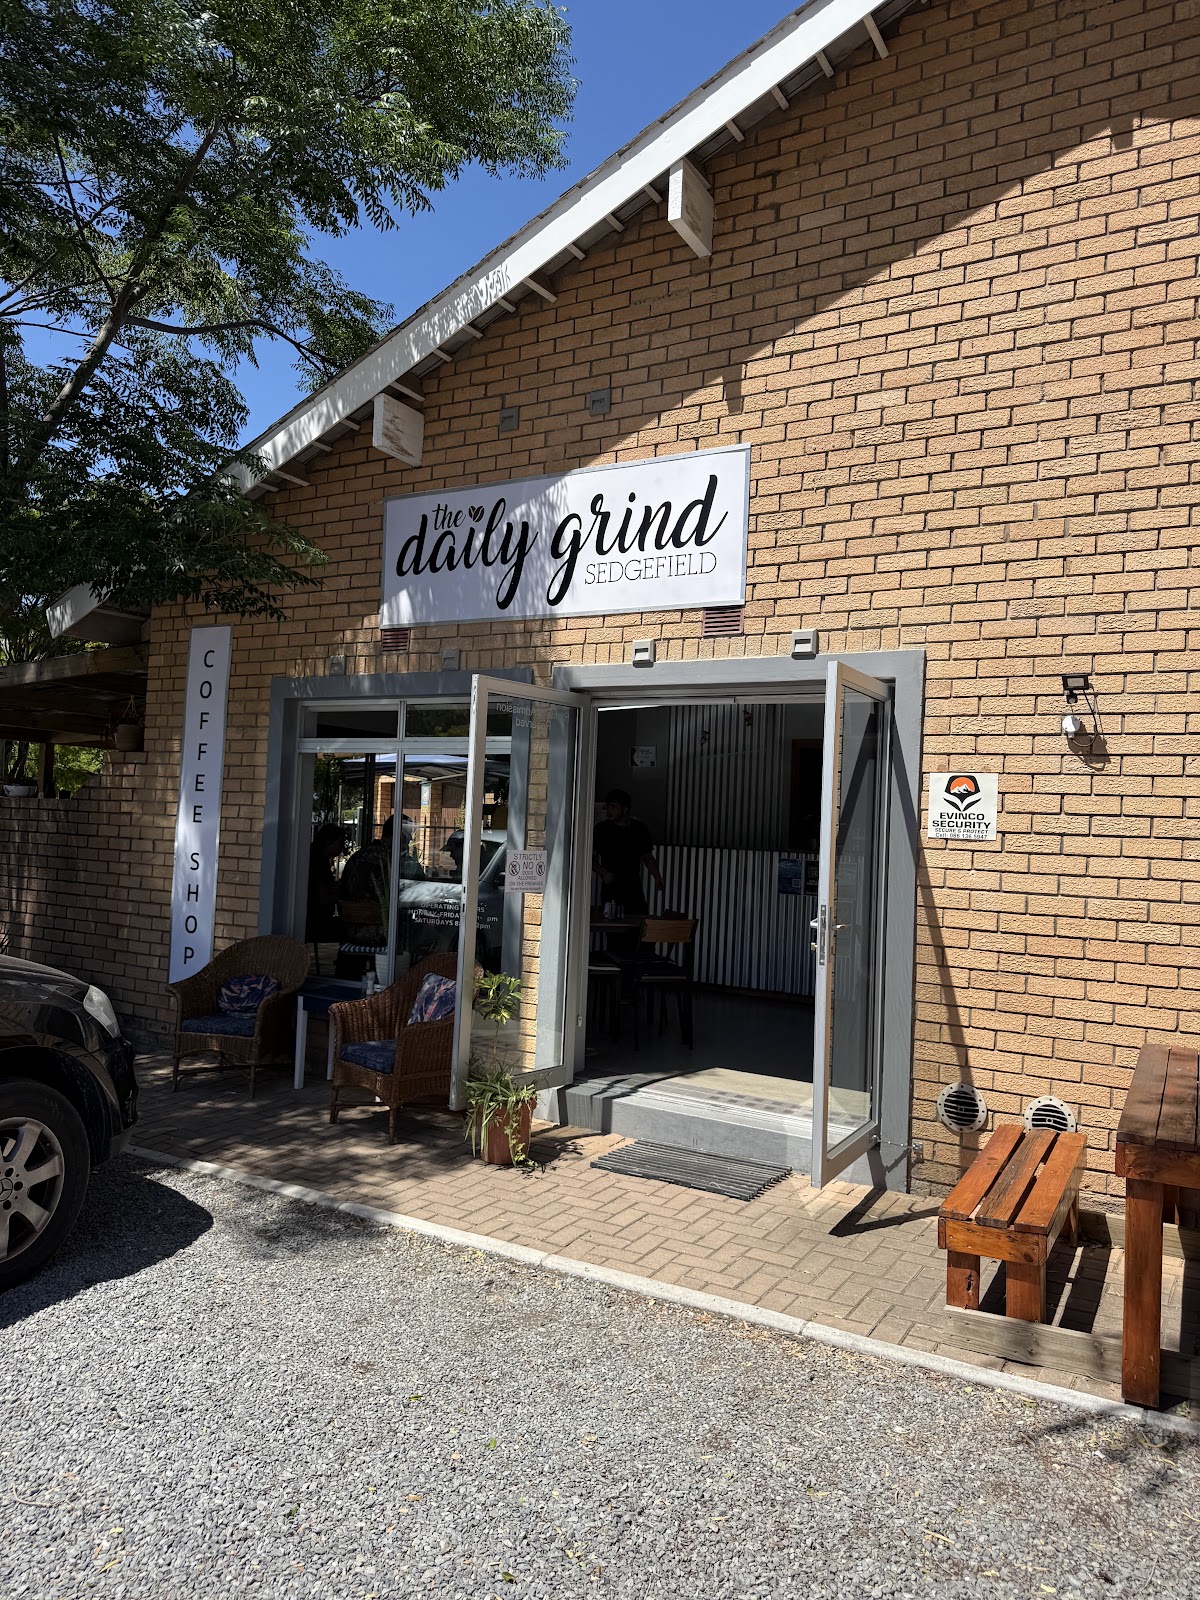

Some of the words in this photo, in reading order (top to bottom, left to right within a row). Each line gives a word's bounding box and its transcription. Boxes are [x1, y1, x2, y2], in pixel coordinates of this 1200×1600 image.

[432, 503, 466, 531] the
[396, 497, 539, 609] daily
[546, 474, 729, 607] grind
[584, 551, 718, 586] SEDGEFIELD
[193, 650, 215, 823] COFFEE
[932, 820, 991, 829] SECURITY
[940, 812, 985, 821] EVINCO
[523, 861, 534, 869] NO
[183, 852, 200, 965] SHOP
[414, 917, 453, 926] SATURDAYS
